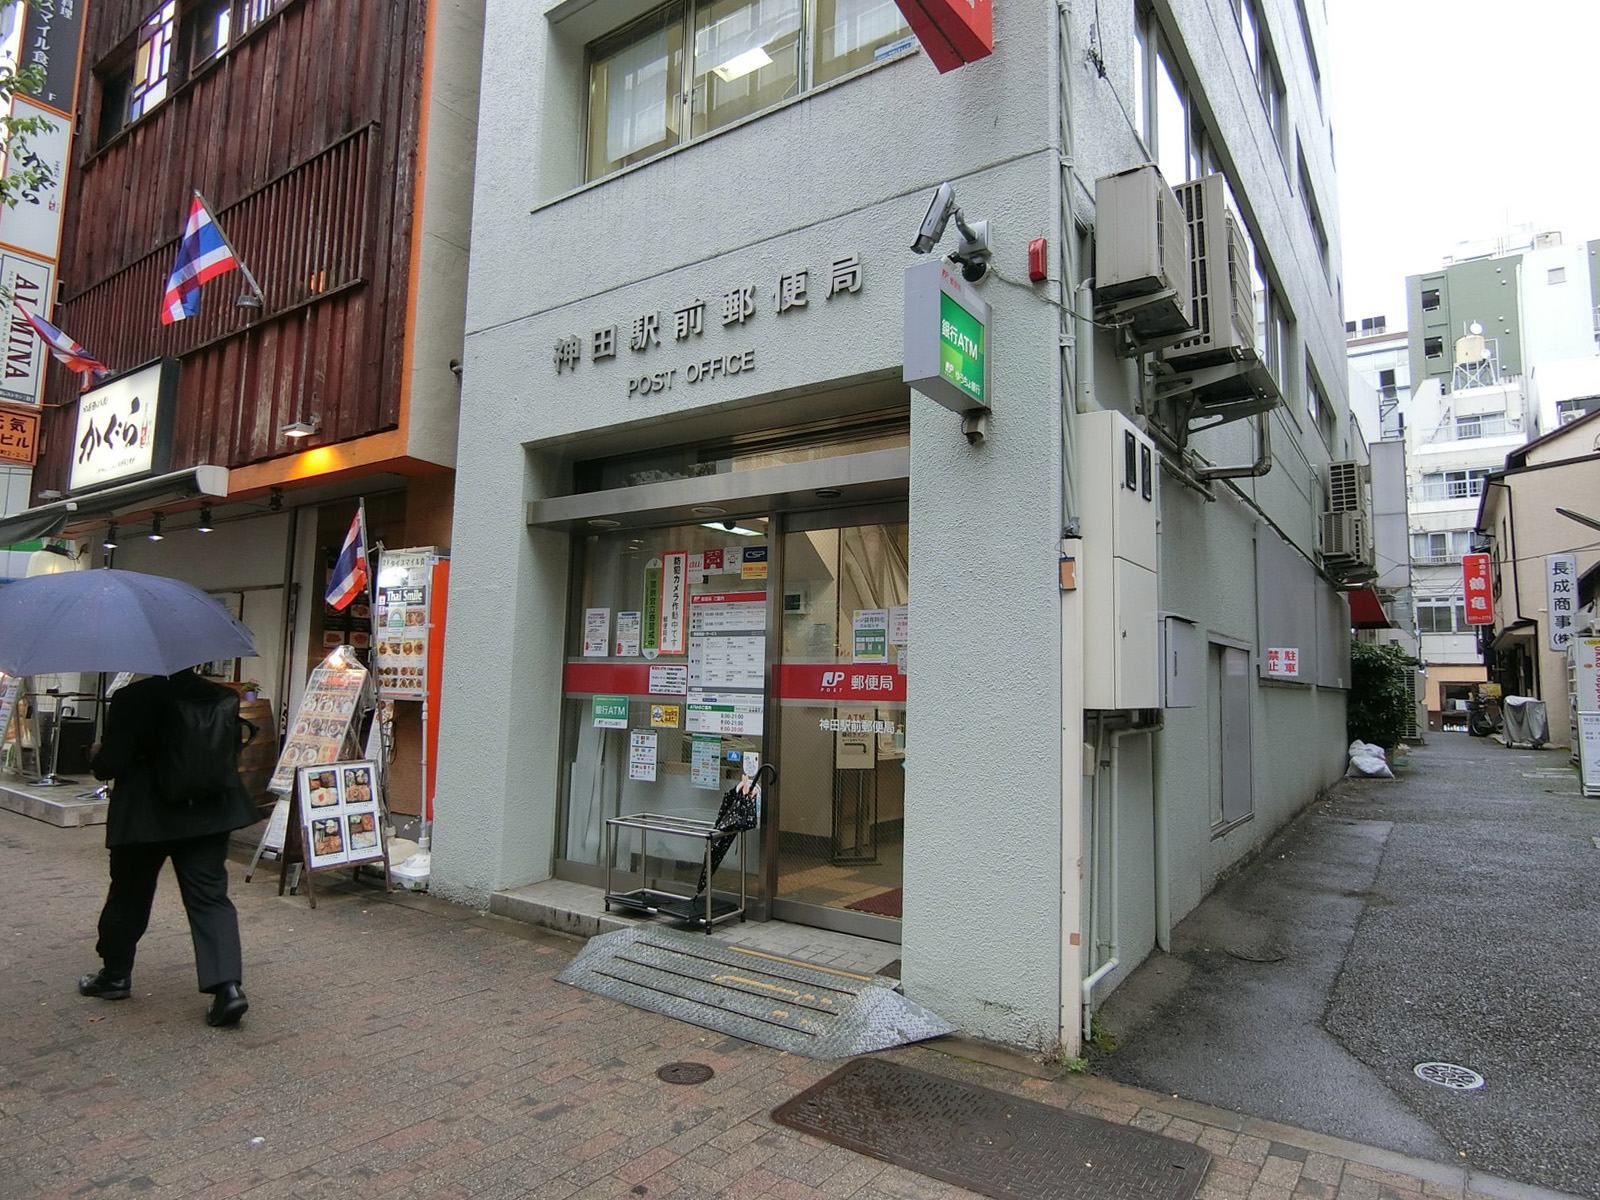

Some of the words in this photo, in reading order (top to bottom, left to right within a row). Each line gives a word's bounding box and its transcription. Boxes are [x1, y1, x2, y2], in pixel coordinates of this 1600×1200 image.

[553, 250, 864, 374] 神田駅前郵便局
[941, 318, 978, 361] 銀行ATM
[628, 368, 677, 398] POST
[686, 349, 755, 384] OFFICE
[79, 396, 140, 465] かぐら
[1, 433, 30, 448] ビル
[745, 550, 765, 559] CSP
[387, 590, 402, 602] Thai
[403, 589, 423, 602] Smile
[851, 674, 894, 691] 郵便局
[819, 718, 895, 734] 神田駅前郵便局
